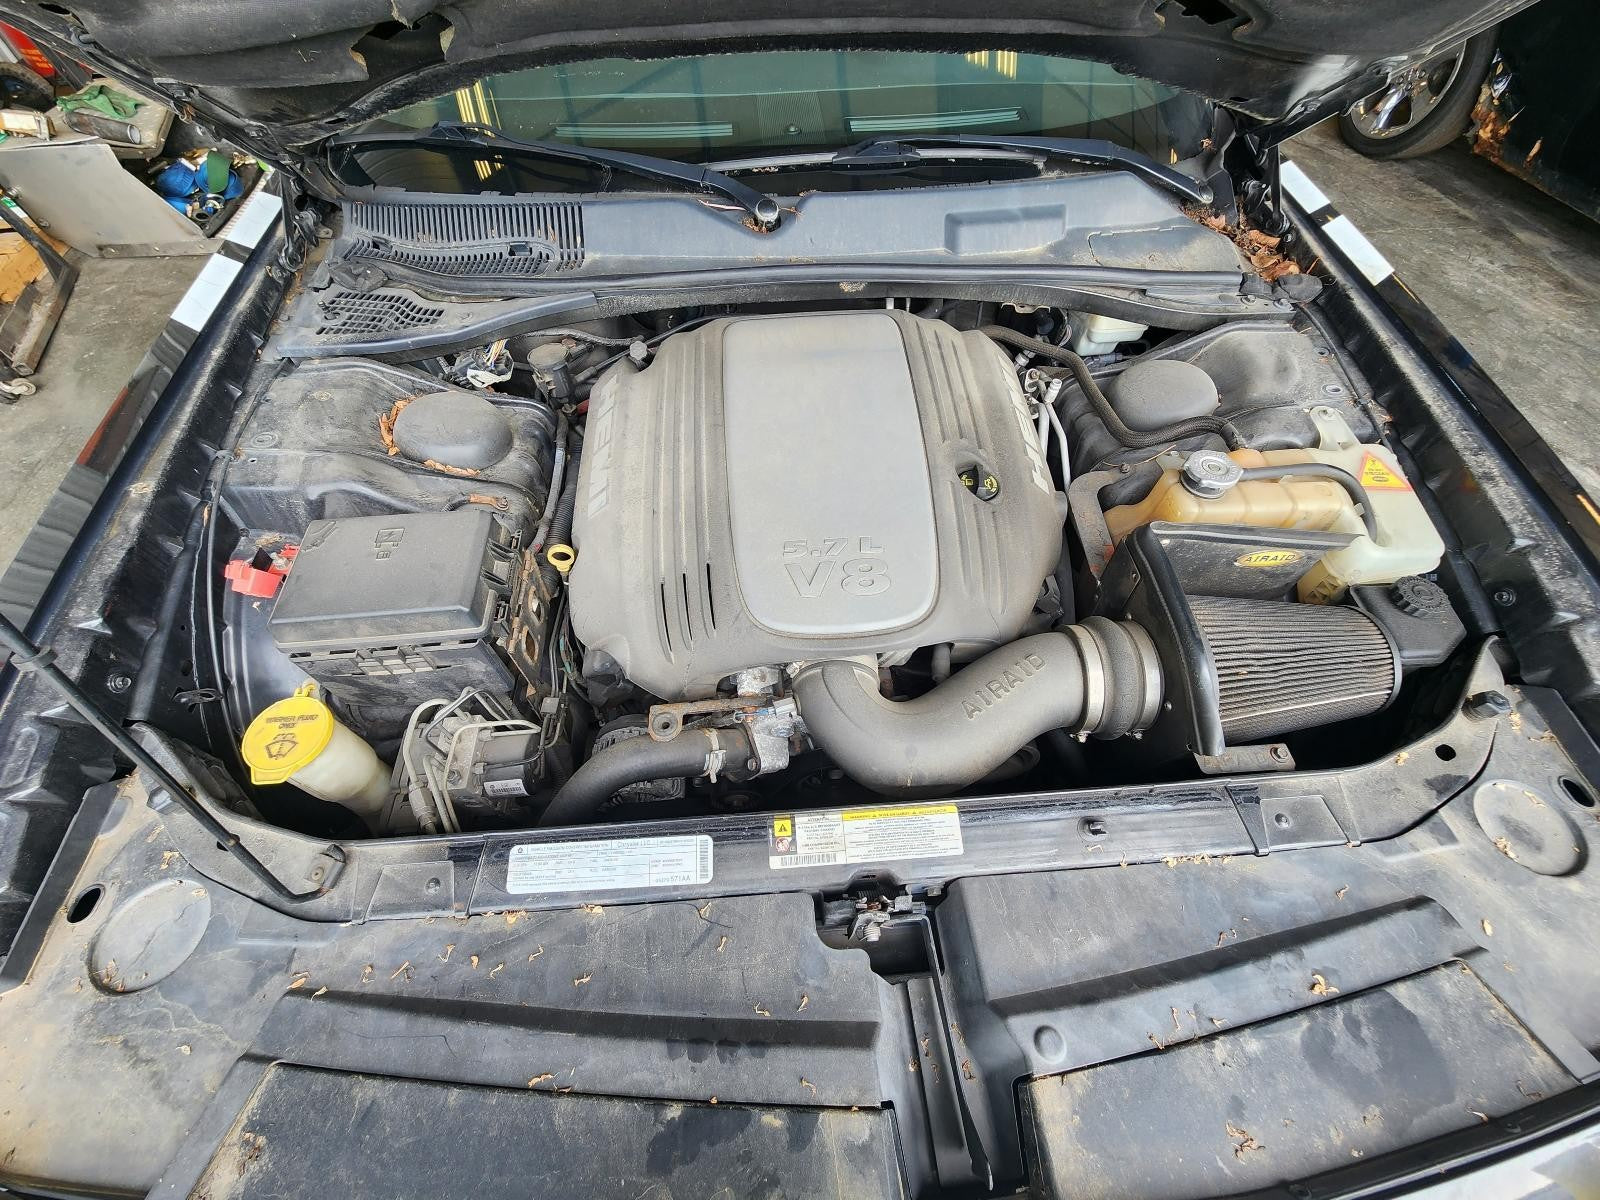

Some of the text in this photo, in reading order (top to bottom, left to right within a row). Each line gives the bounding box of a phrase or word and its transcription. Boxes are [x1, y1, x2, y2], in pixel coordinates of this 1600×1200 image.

[783, 536, 887, 558] 5.7 L
[1245, 554, 1296, 563] AIRAID
[783, 557, 892, 598] V8
[961, 653, 1046, 720] AIRAID
